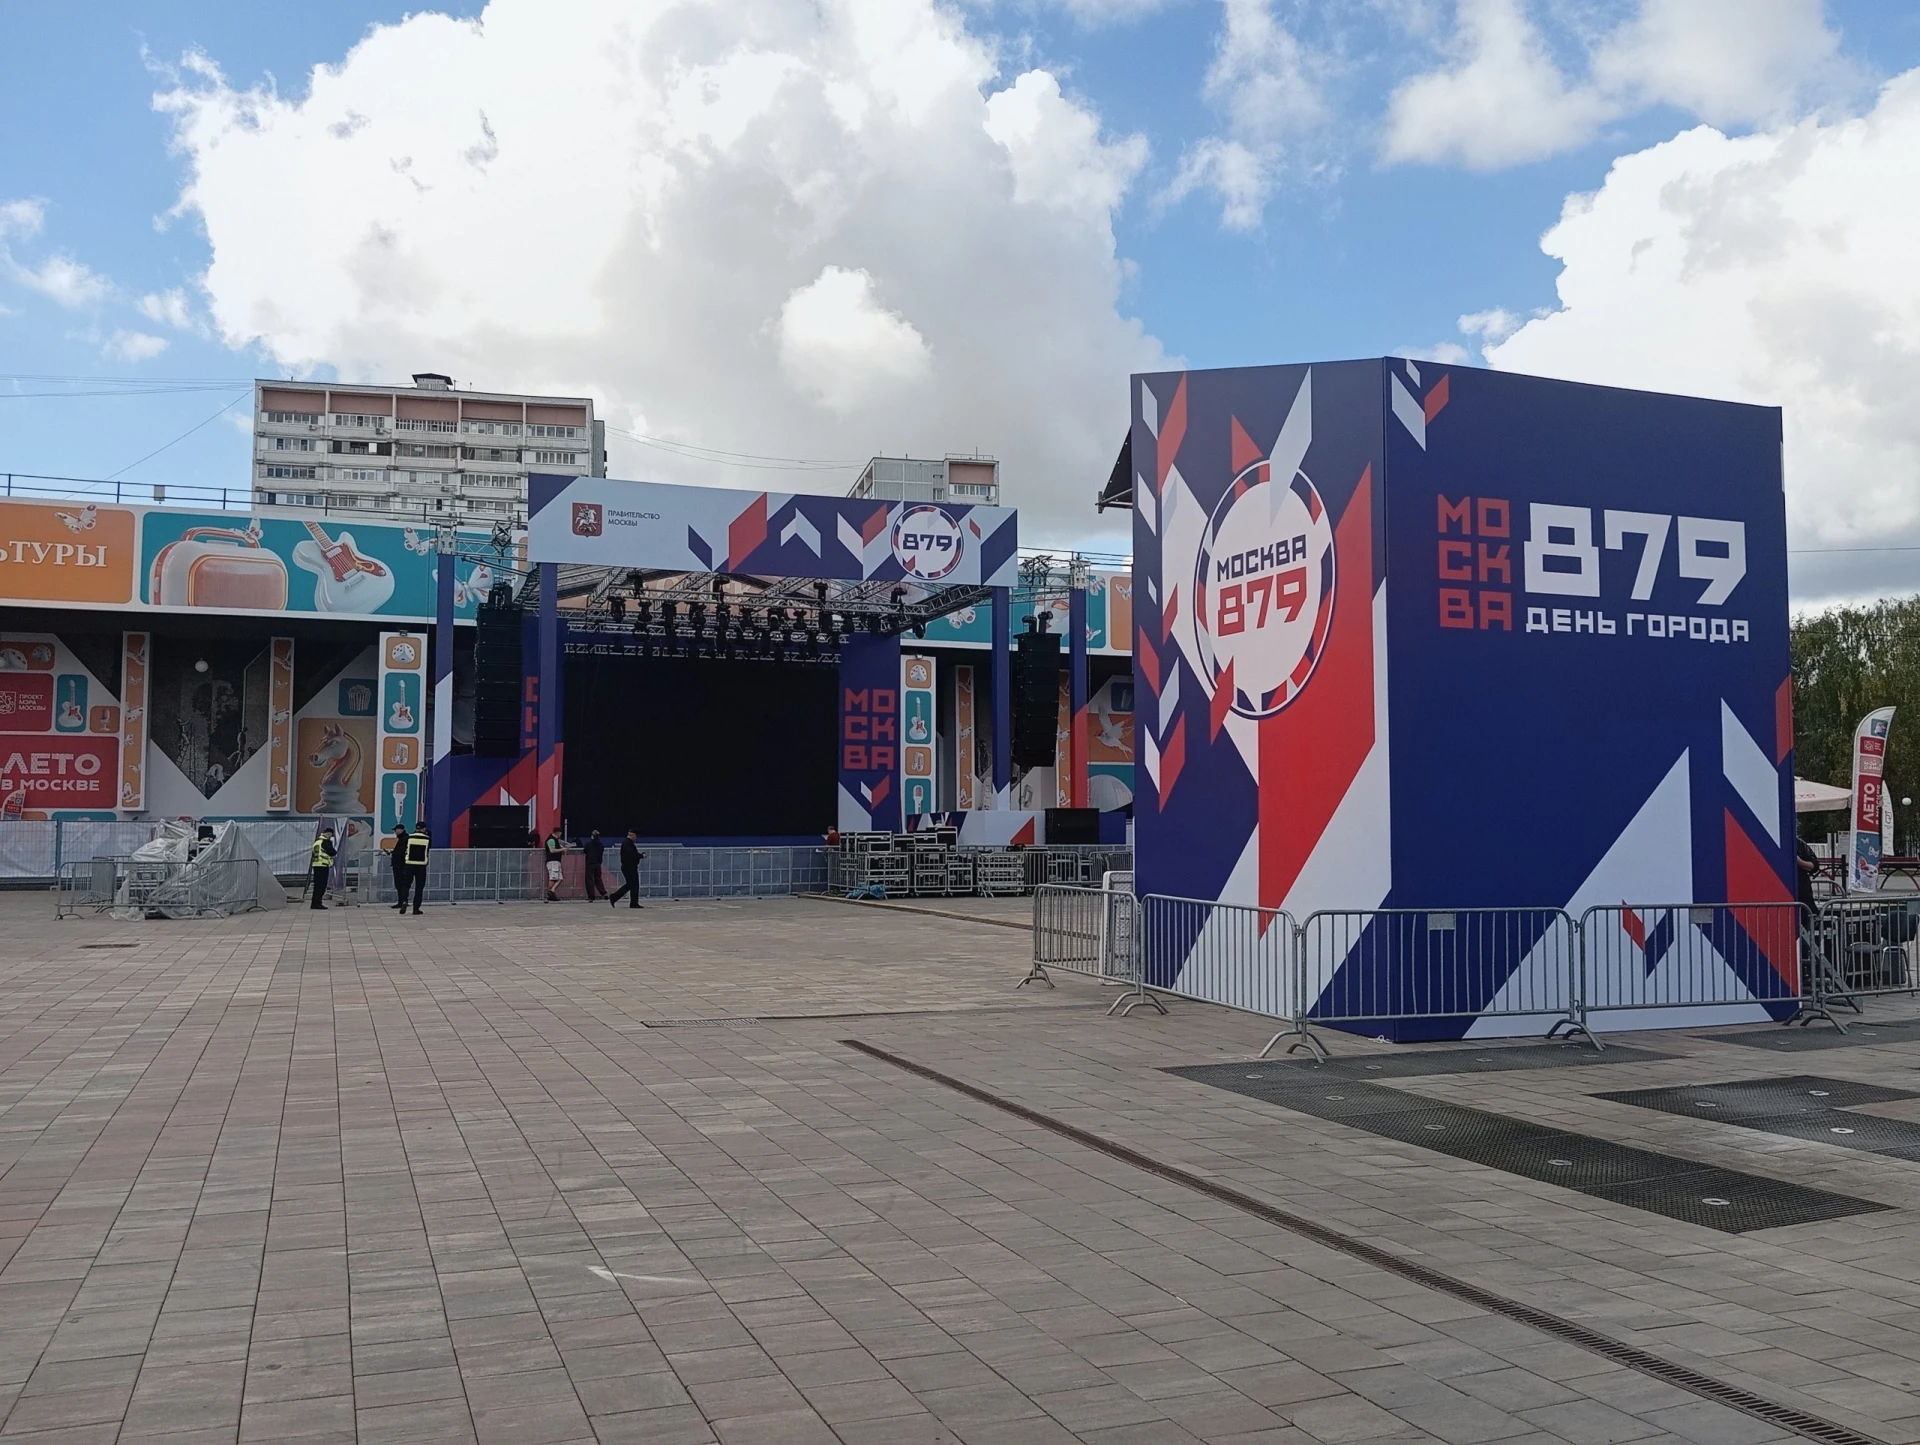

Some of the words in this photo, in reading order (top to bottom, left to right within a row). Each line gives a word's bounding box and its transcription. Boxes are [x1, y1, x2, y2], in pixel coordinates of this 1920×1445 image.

[607, 509, 661, 520] ПРАВИТЕЛЬСТВО
[607, 518, 638, 527] МОСКВЫ
[1437, 494, 1510, 538] МО
[902, 533, 953, 552] 879
[1217, 534, 1307, 583] МОСКВА
[1438, 540, 1511, 584] СК
[1524, 503, 1747, 606] 879
[1217, 566, 1308, 637] 879
[1439, 588, 1513, 631] ВА
[1526, 607, 1617, 635] ДЕНЬ
[1626, 613, 1749, 644] ГОРОДА
[1, 779, 13, 790] В
[20, 779, 100, 791] МОСКВЕ
[2, 752, 101, 776] ЛЕТО
[1863, 782, 1875, 824] ЛЕТО
